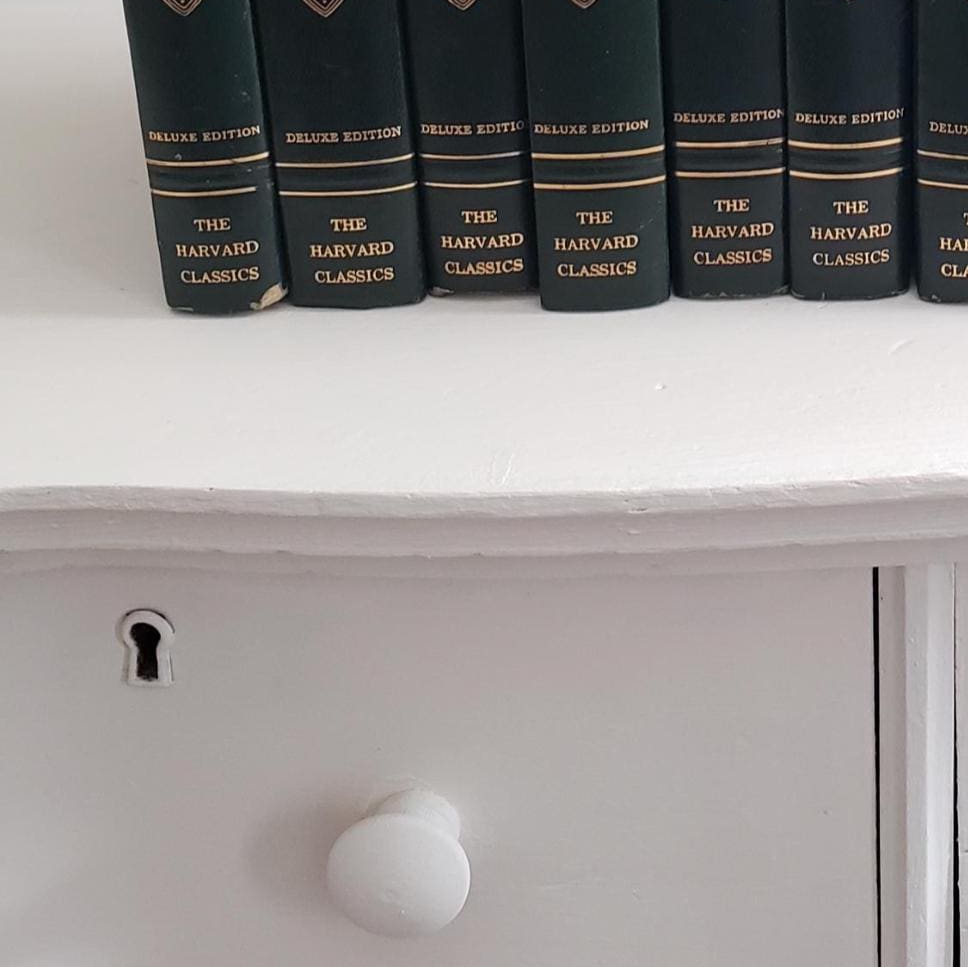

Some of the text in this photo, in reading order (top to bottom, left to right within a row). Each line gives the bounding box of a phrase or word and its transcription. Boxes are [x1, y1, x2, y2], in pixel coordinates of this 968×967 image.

[673, 108, 784, 124] DELUXE EDITION
[795, 107, 904, 124] DELUXE EDITION
[149, 125, 260, 142] DELUXE EDITION
[285, 126, 402, 144] DELUXE EDITION
[420, 120, 525, 135] DELUXE EDITIO
[534, 119, 649, 135] DELUXE EDITION
[713, 199, 750, 212] THE
[833, 200, 869, 214] THE
[193, 218, 231, 232] THE
[330, 217, 367, 232] THE
[461, 210, 497, 224] THE
[576, 211, 613, 225] THE
[691, 222, 774, 239] HARVARD
[810, 223, 892, 241] HARVARD
[175, 240, 259, 258] HARVARD
[440, 233, 524, 249] HARVARD
[554, 235, 639, 251] HARVARD
[310, 241, 394, 258] HARVARD
[693, 248, 772, 265] CLASSICS
[444, 258, 524, 275] CLASSICS
[812, 250, 890, 267] CLASSICS
[180, 266, 260, 283] CLASSICS
[314, 267, 394, 283] CLASSICS
[557, 261, 637, 277] CLASSICS
